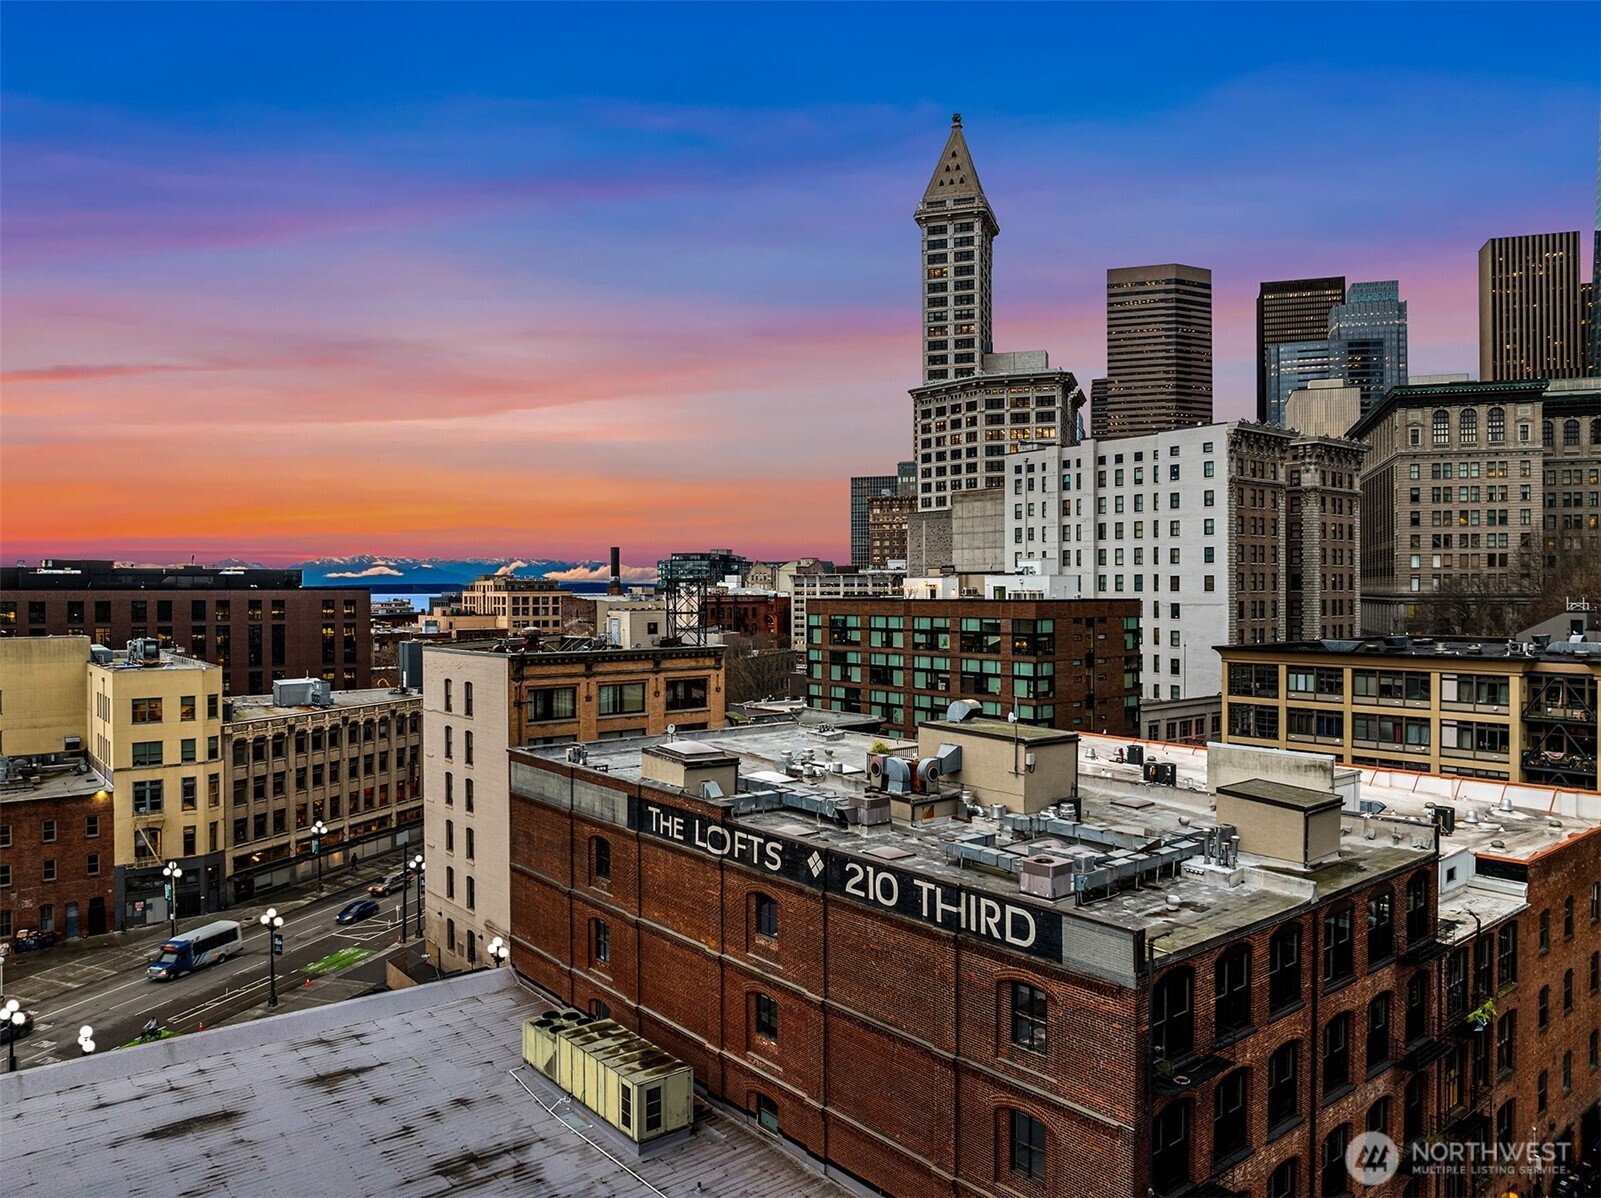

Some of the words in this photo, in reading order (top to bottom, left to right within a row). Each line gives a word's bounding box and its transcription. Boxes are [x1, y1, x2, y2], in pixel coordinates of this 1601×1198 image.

[648, 806, 684, 841] THE
[694, 820, 783, 871] LOFTS
[845, 862, 899, 907] 210
[913, 878, 1036, 948] THIRD
